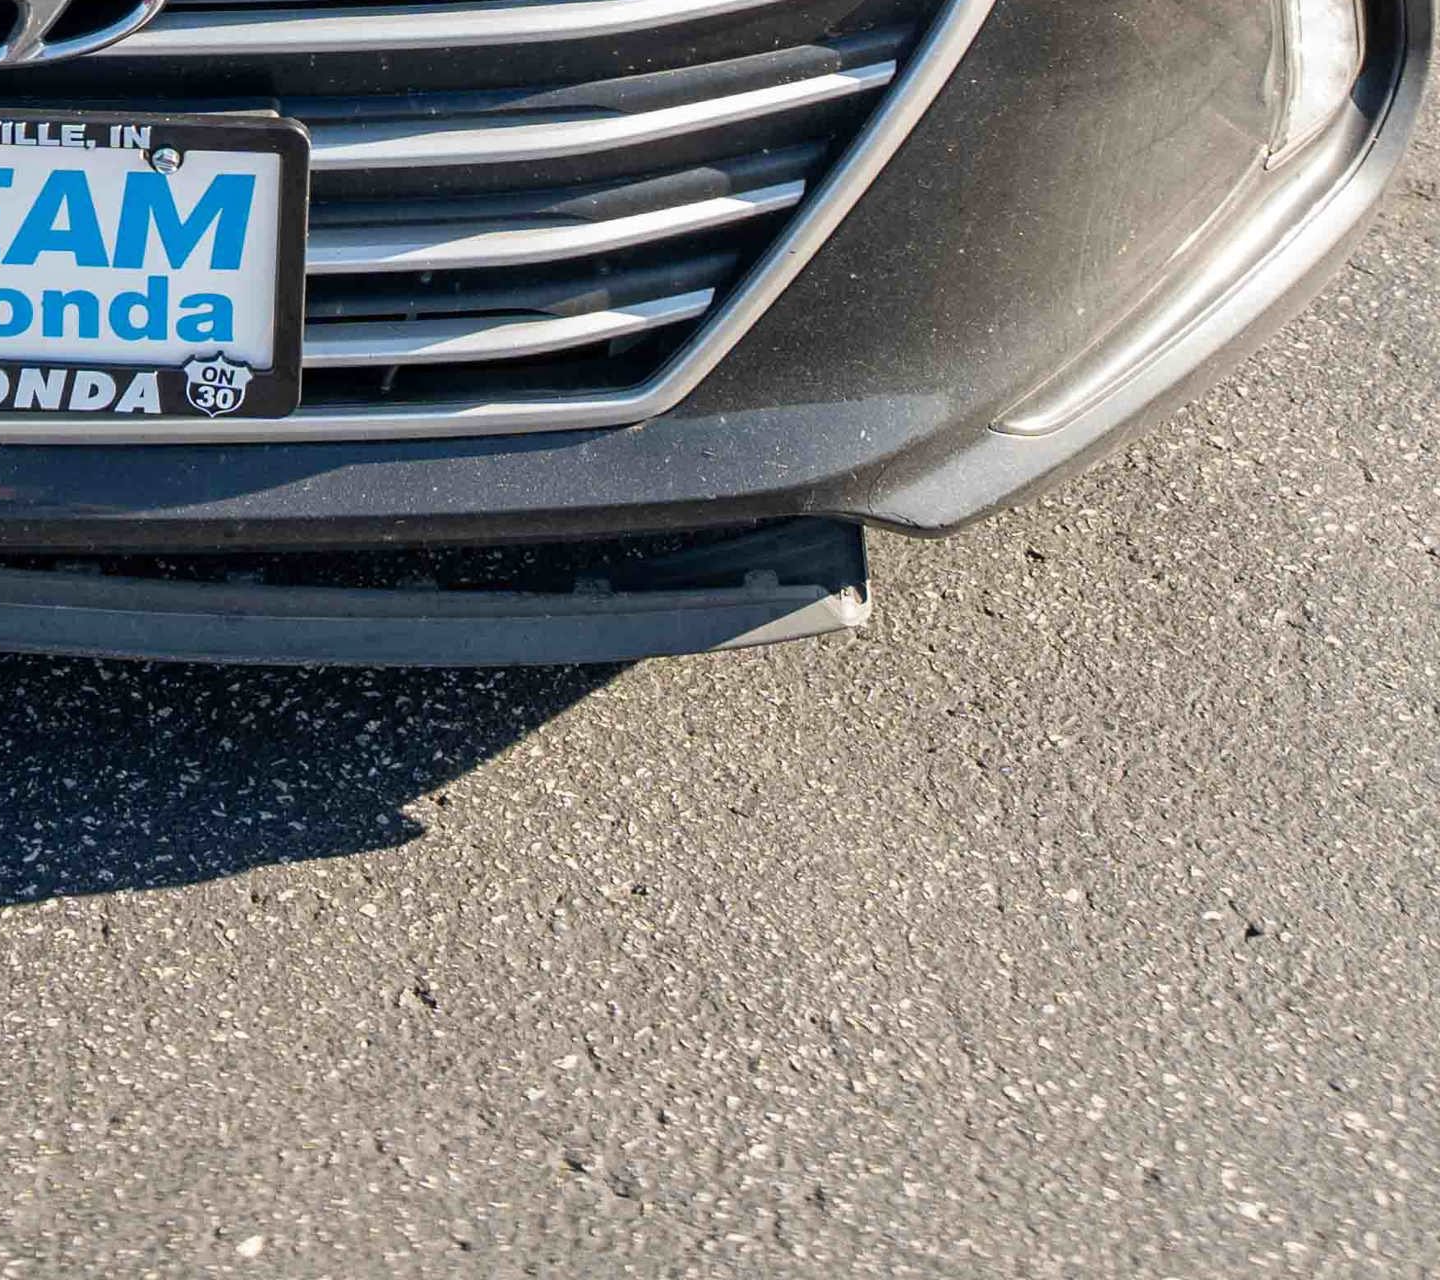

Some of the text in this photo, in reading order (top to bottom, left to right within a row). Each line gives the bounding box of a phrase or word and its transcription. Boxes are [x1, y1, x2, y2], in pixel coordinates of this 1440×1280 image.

[109, 124, 152, 150] IN
[202, 366, 235, 386] ON
[195, 385, 235, 409] 30
